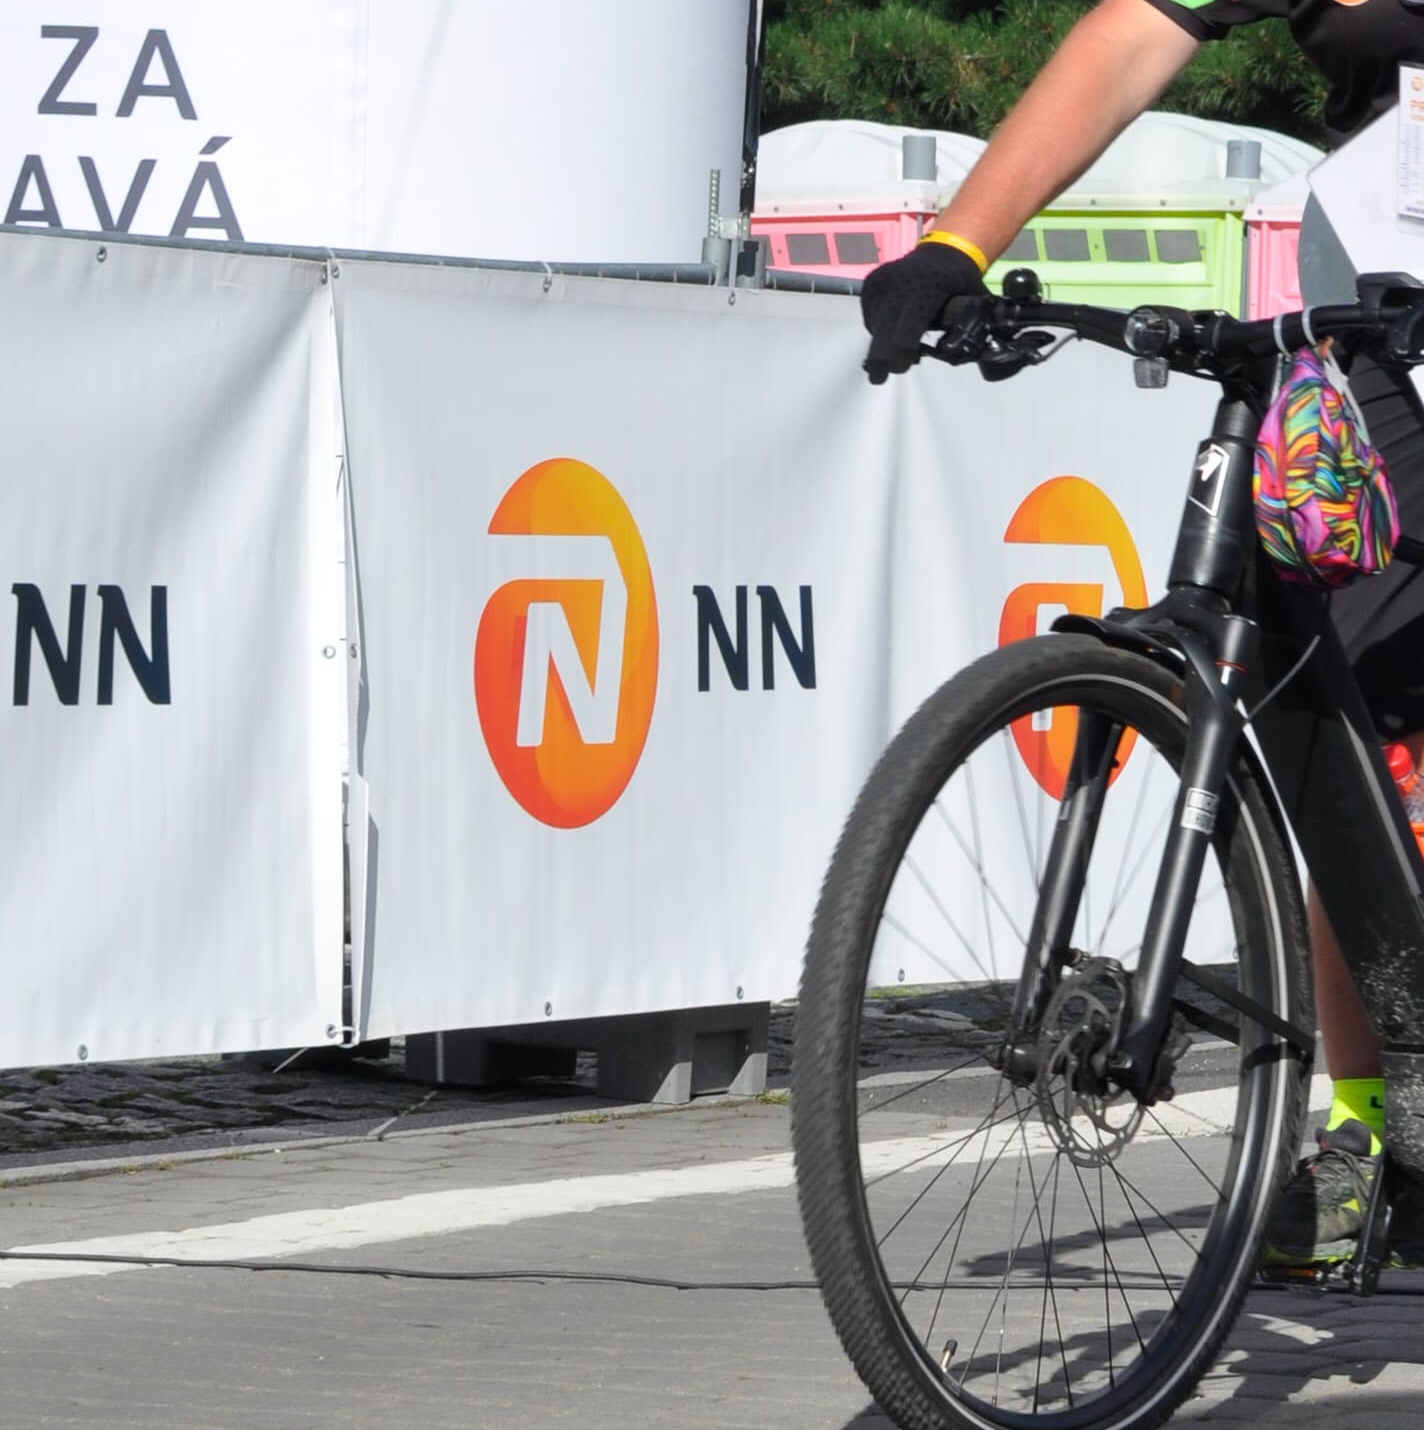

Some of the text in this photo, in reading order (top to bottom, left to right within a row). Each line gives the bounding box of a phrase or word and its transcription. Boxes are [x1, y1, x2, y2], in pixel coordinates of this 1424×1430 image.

[37, 24, 199, 121] ZA
[2, 135, 246, 242] AVÁ
[11, 583, 172, 706] NN
[692, 584, 818, 693] NN
